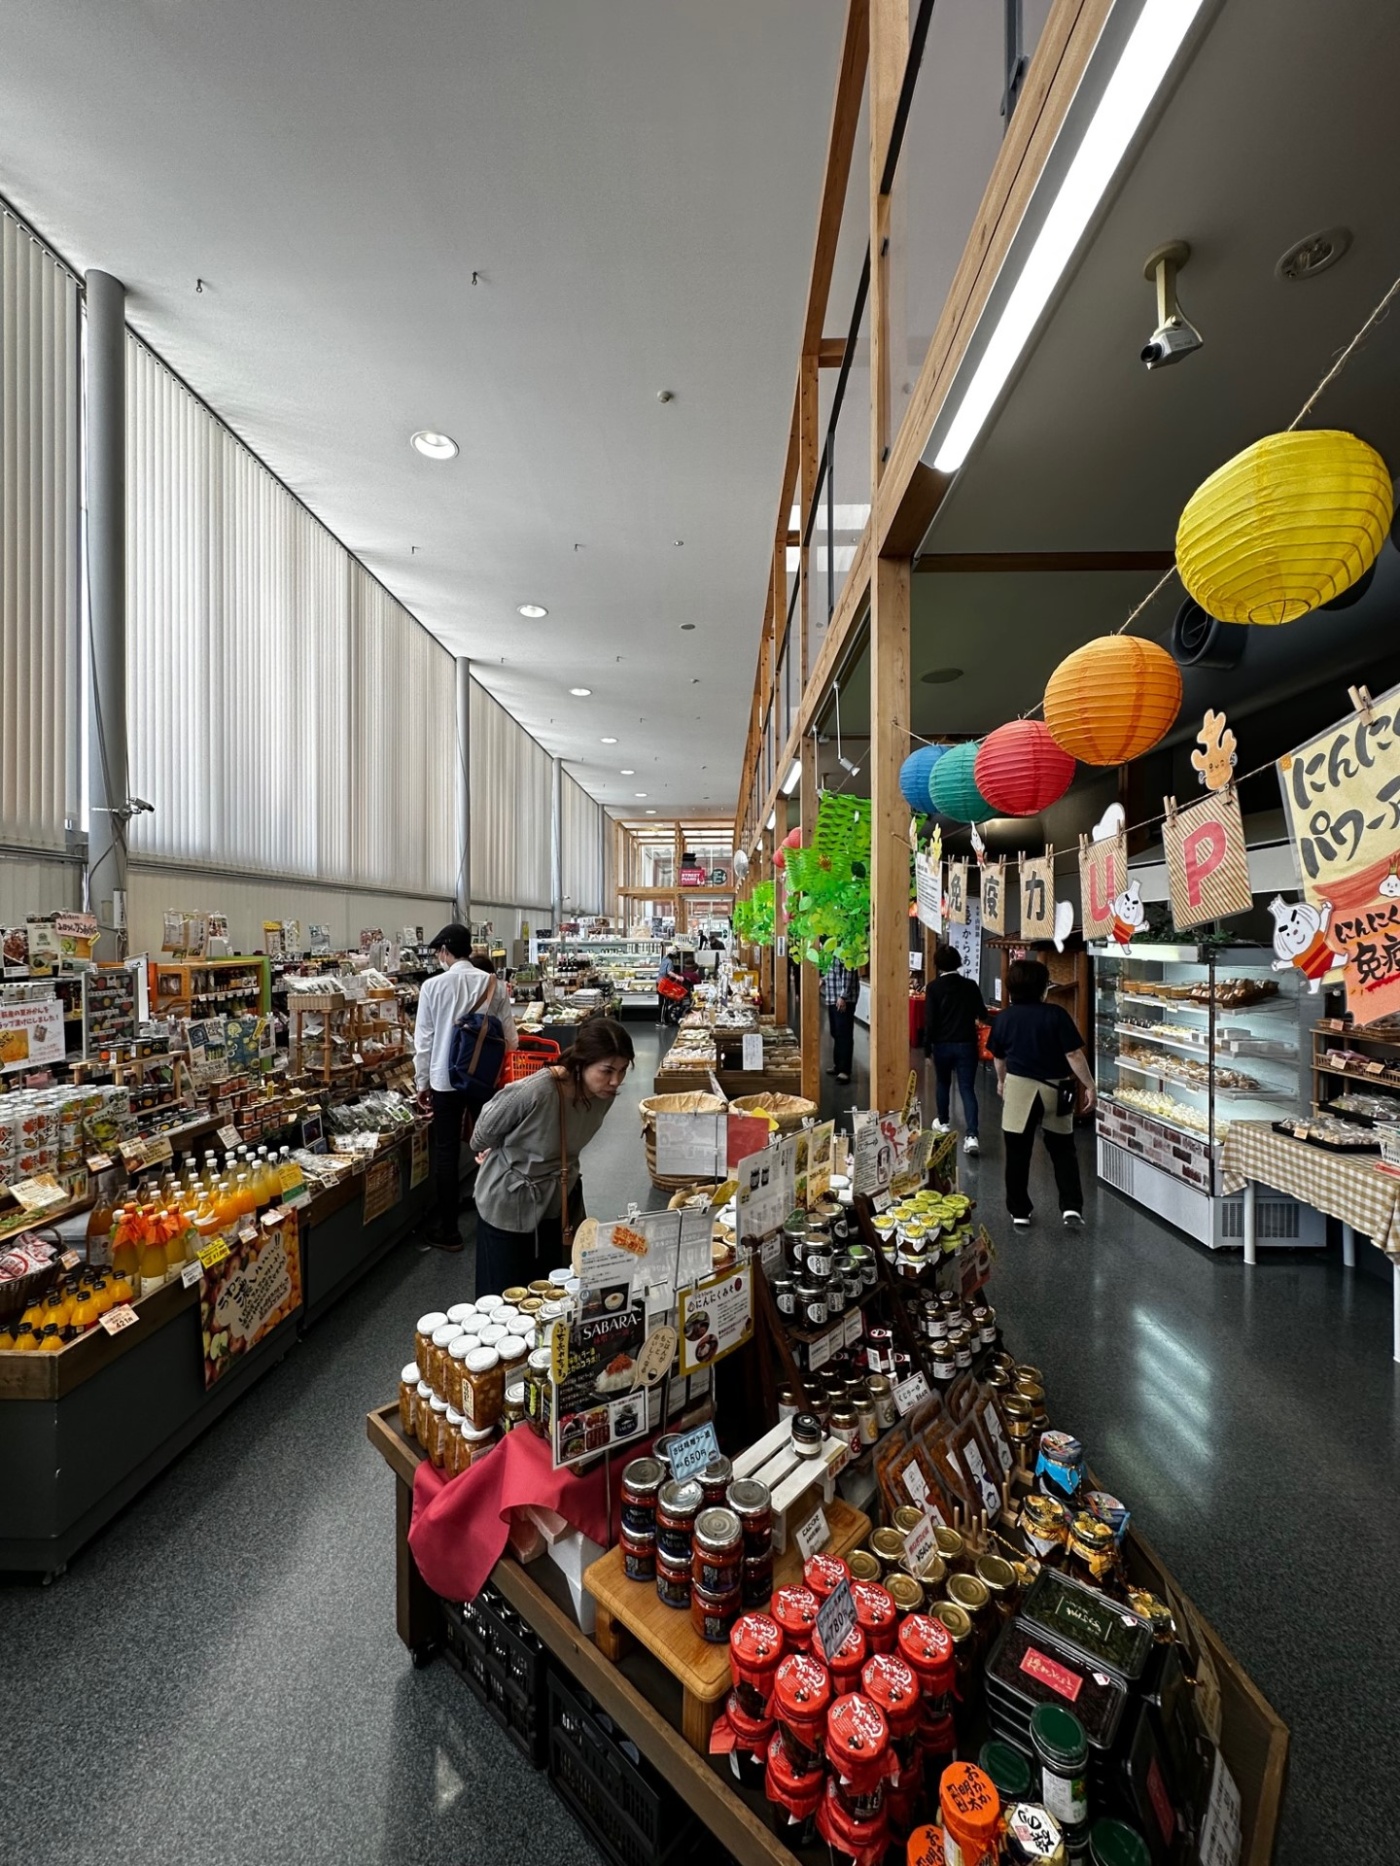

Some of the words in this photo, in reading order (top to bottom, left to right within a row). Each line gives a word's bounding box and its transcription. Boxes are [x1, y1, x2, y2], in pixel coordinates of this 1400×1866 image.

[1293, 707, 1400, 810] にんに
[984, 875, 999, 919] 疫
[1026, 871, 1045, 921] 力
[1089, 854, 1115, 922] U
[1184, 820, 1228, 908] P
[696, 1285, 735, 1309] にんにくみそ
